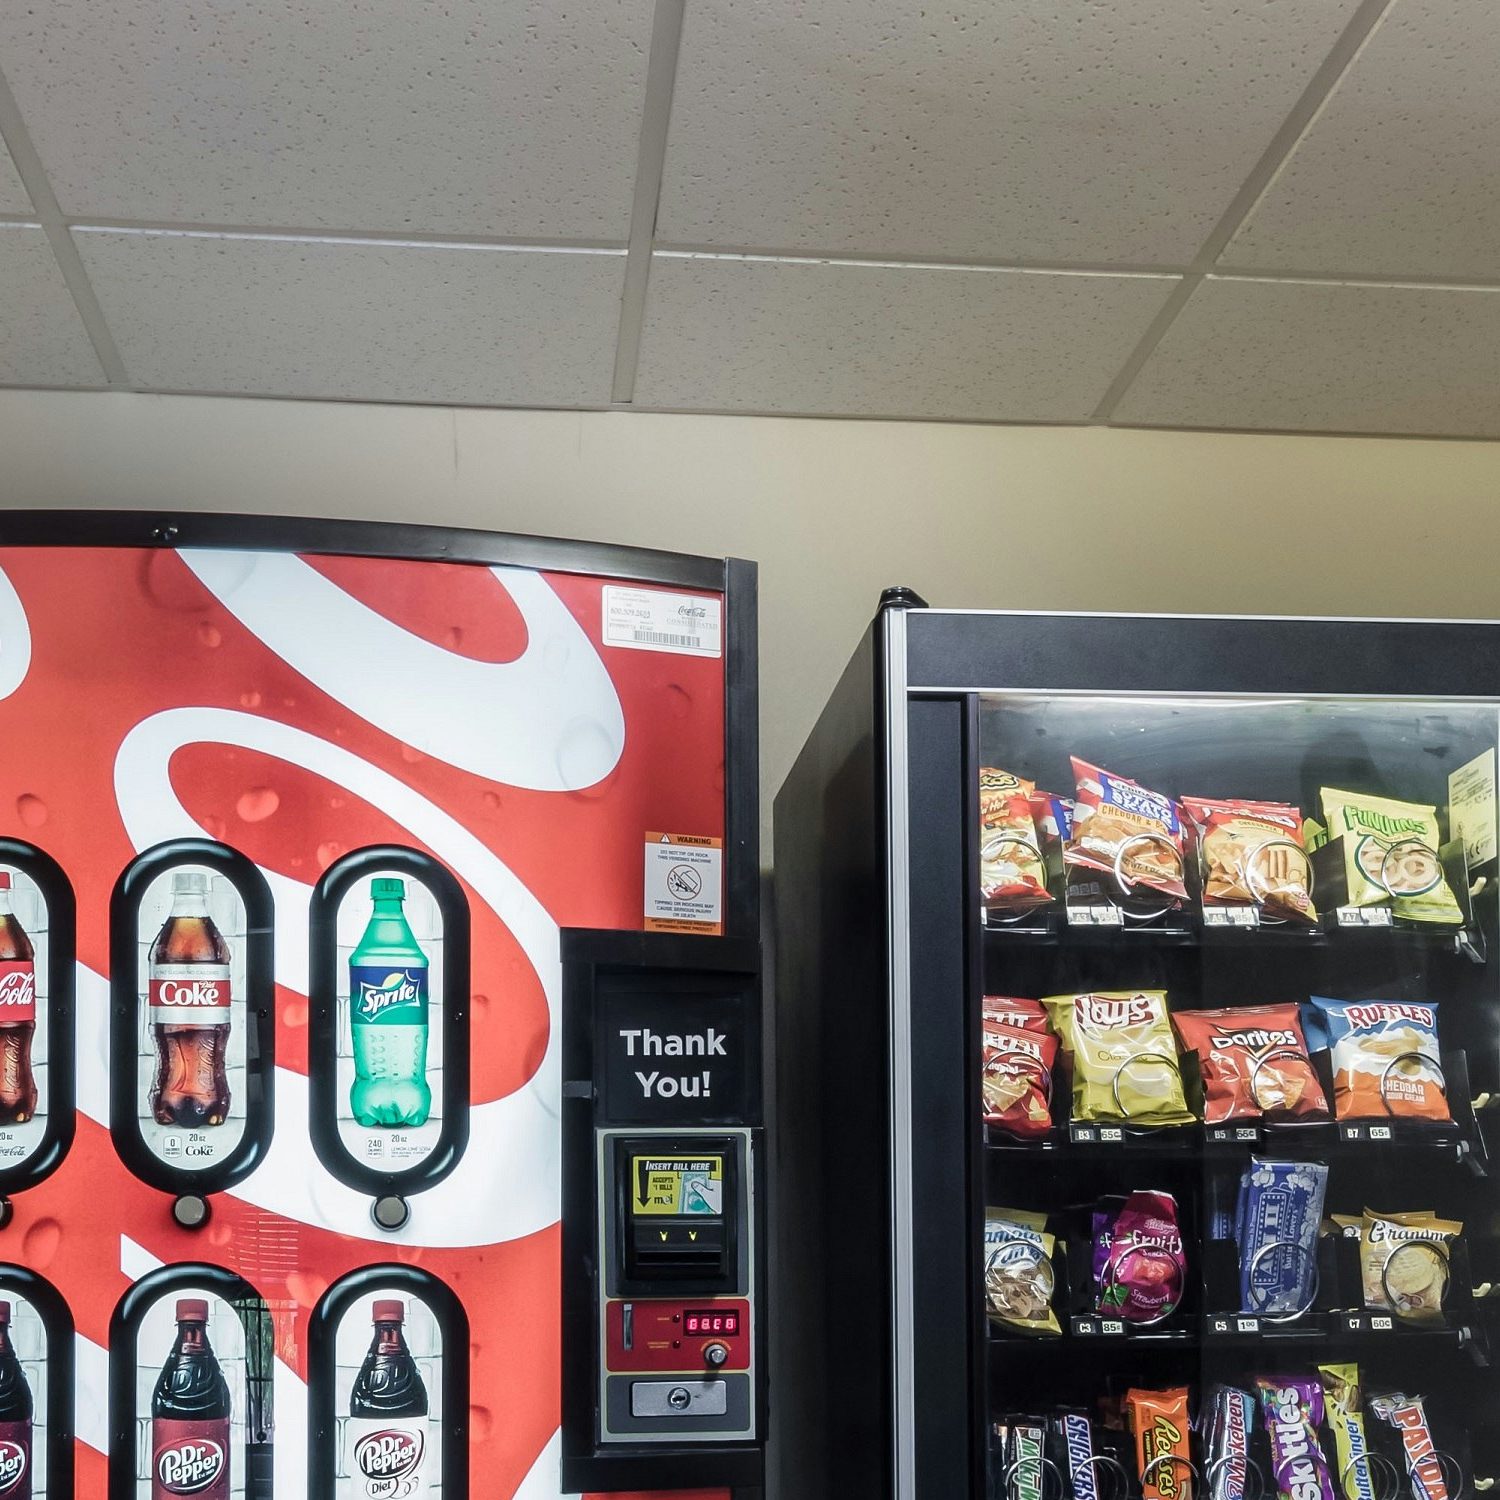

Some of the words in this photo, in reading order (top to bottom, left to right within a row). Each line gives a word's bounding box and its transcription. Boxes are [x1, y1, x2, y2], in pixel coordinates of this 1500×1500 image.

[1101, 804, 1142, 825] CHEDDAR
[1343, 805, 1429, 837] FUNYUNS
[677, 836, 712, 845] WARNING
[199, 980, 216, 989] Diet
[159, 981, 219, 1006] Coke
[362, 982, 415, 1015] Sprite
[1346, 1004, 1435, 1029] RUFFLES
[619, 1028, 727, 1056] Thank
[1211, 1029, 1298, 1050] Doritos
[635, 1071, 711, 1098] You!
[1385, 1079, 1424, 1095] HEDDAR
[1386, 1091, 1403, 1100] SOUR
[1404, 1093, 1425, 1103] CREAM
[189, 1133, 198, 1142] 20
[391, 1134, 400, 1142] 20
[1078, 1130, 1090, 1140] B3
[1214, 1130, 1226, 1139] B5
[185, 1146, 213, 1156] Coke
[368, 1139, 382, 1148] 240
[645, 1160, 672, 1171] INSERT
[672, 1161, 689, 1171] BILL
[690, 1162, 710, 1171] HERE
[652, 1176, 674, 1184] ACCEPTS
[654, 1193, 673, 1205] mei
[1132, 1229, 1183, 1255] Fruity
[1130, 1288, 1170, 1304] Strawberry
[1079, 1323, 1091, 1332] C3
[1215, 1321, 1227, 1331] C5
[1349, 1319, 1360, 1329] C7
[379, 1436, 404, 1454] Dr
[1226, 1390, 1247, 1486] Musketeers
[181, 1445, 206, 1464] Dr
[365, 1440, 417, 1474] Pepper
[165, 1449, 220, 1485] Pepper
[371, 1478, 392, 1494] Diet
